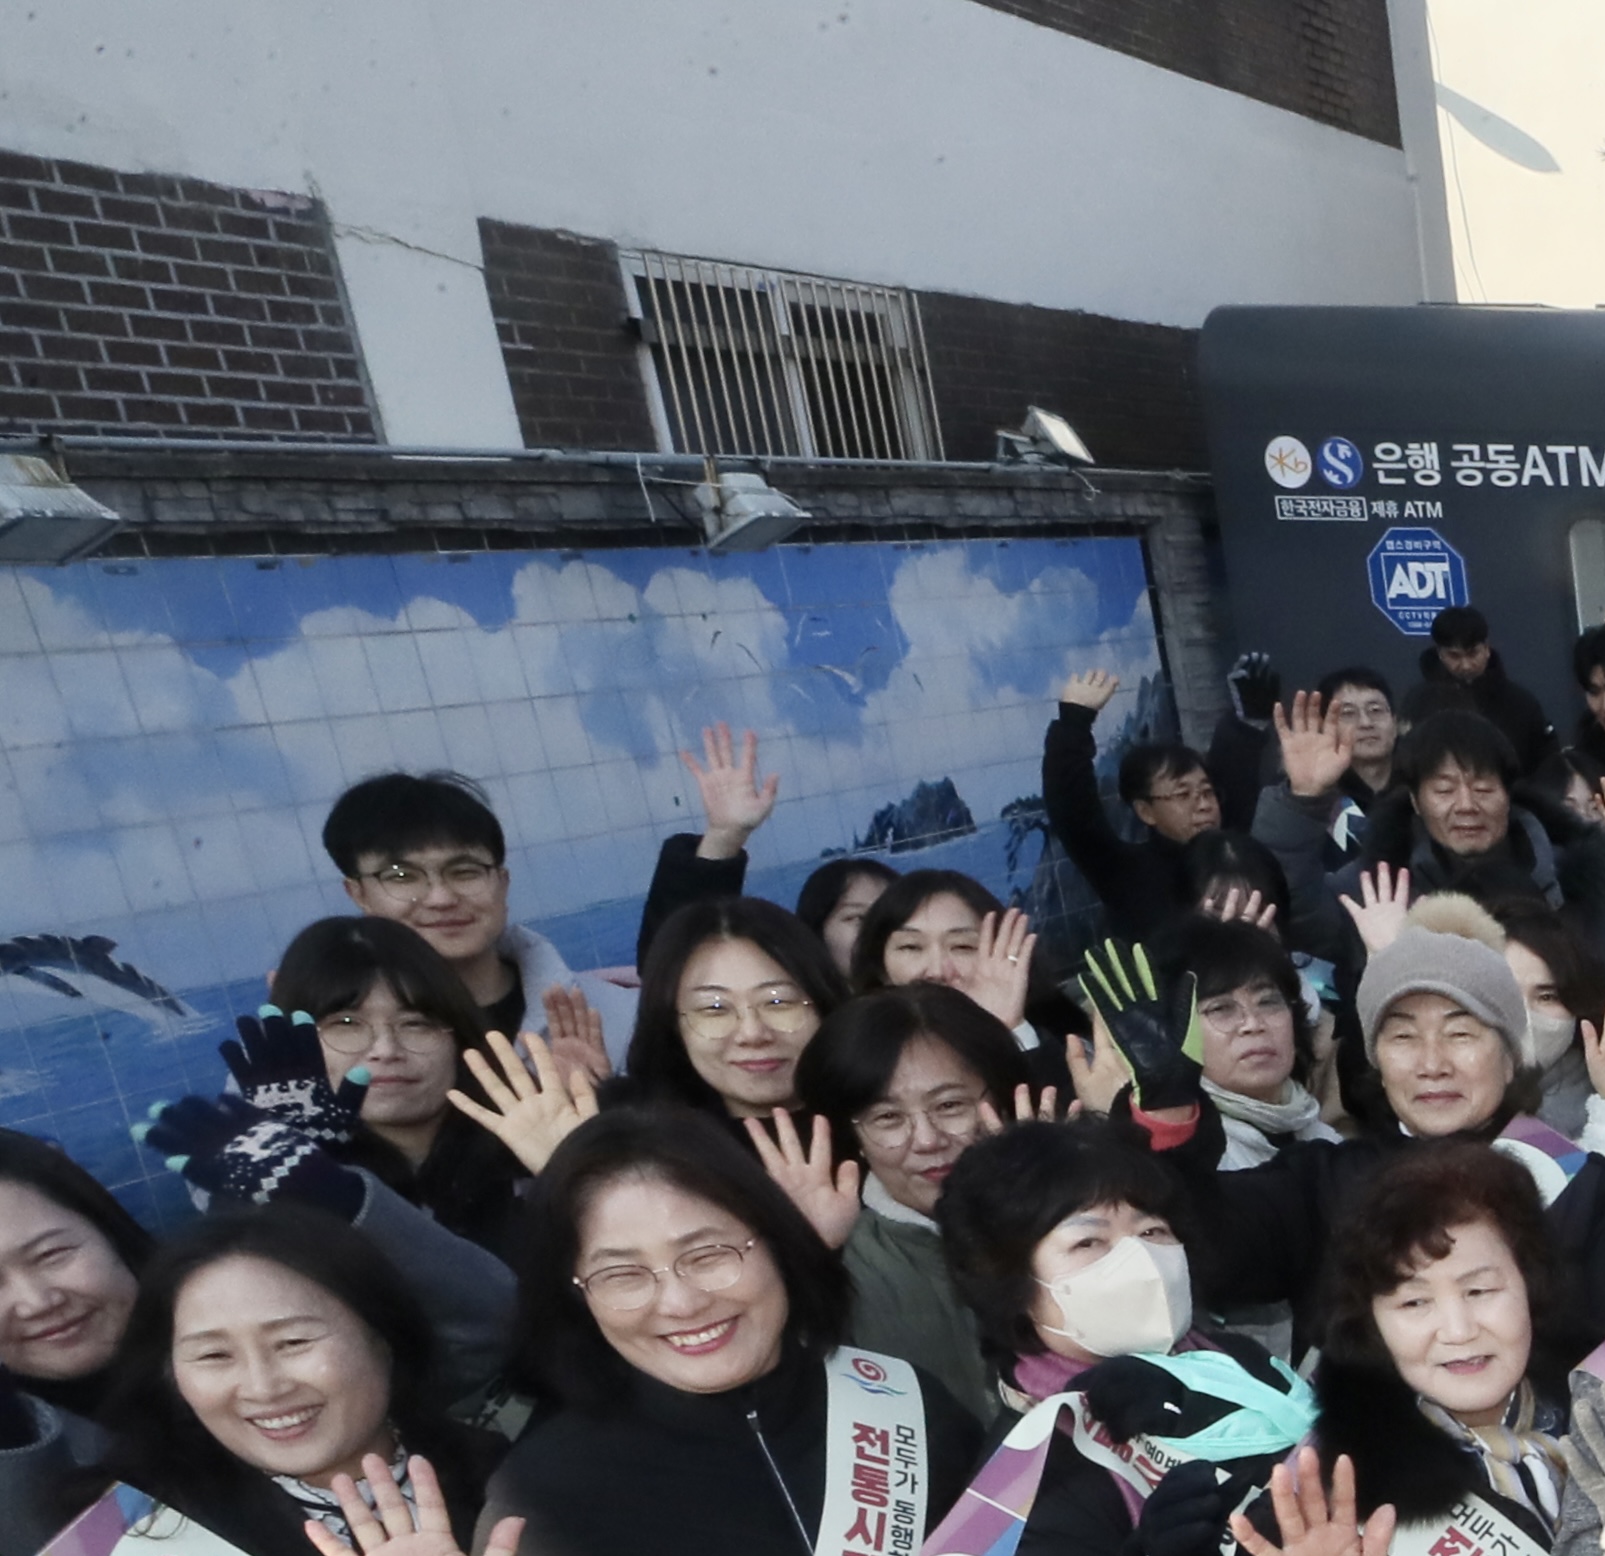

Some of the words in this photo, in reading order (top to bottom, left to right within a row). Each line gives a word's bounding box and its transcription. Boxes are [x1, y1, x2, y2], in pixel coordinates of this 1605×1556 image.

[1373, 442, 1442, 487] 은행
[1279, 499, 1363, 518] 한국전자금융
[1371, 500, 1399, 518] 제휴
[1404, 501, 1443, 519] ATM
[1387, 561, 1449, 599] ADT
[894, 1424, 919, 1495] 모두가
